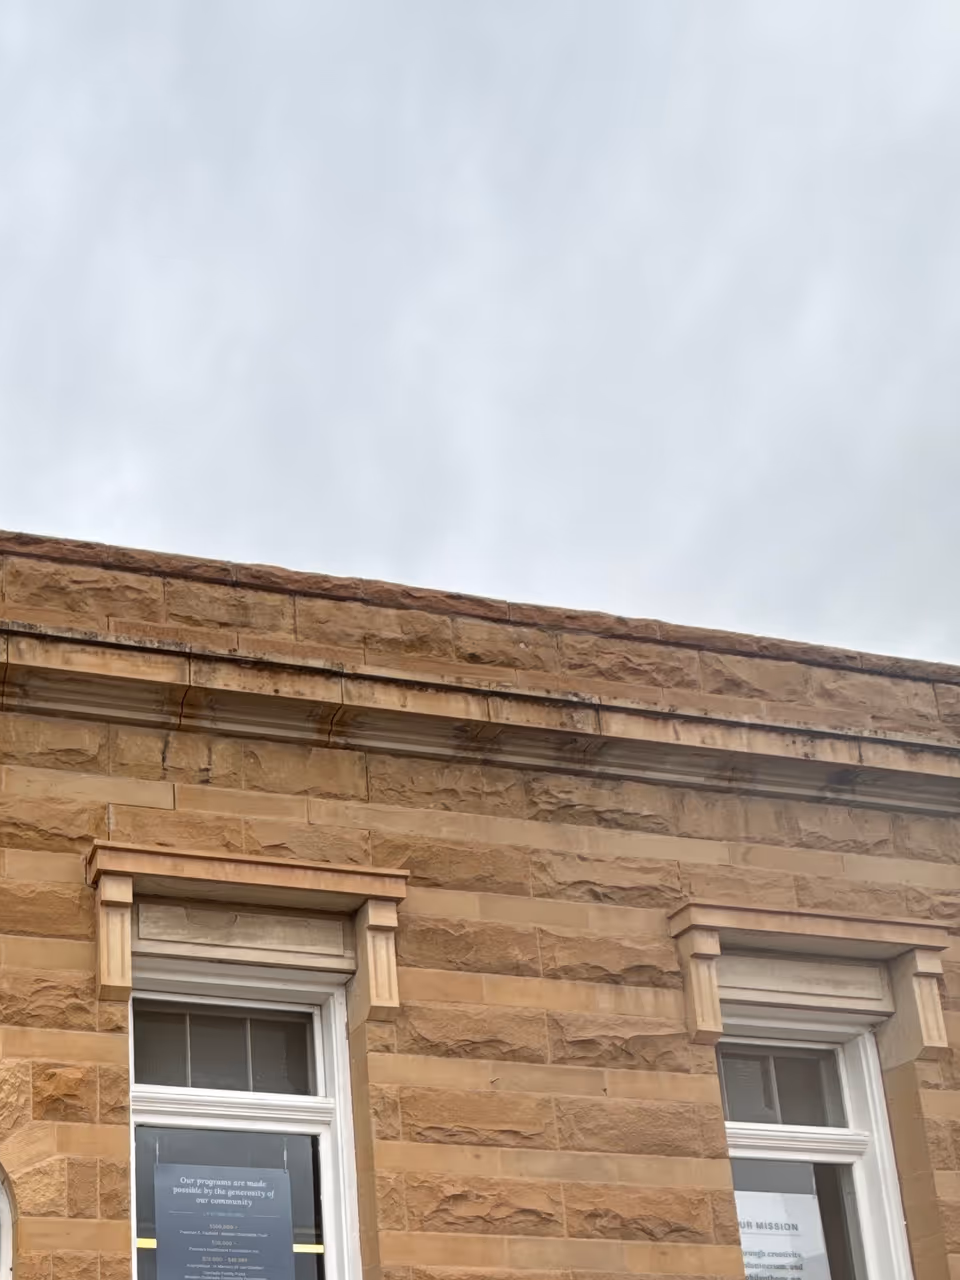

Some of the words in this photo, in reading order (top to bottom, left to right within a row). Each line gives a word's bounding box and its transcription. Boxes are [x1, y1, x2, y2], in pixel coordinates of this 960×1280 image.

[180, 1176, 195, 1184] Our
[197, 1178, 231, 1187] programs
[246, 1179, 267, 1187] made
[173, 1186, 201, 1195] possible
[203, 1187, 213, 1197] by
[214, 1187, 226, 1195] the
[227, 1189, 265, 1199] generosity
[267, 1190, 275, 1199] of
[211, 1197, 253, 1208] community
[737, 1220, 753, 1230] UR
[755, 1221, 799, 1232] MISSION
[790, 1263, 804, 1271] and
